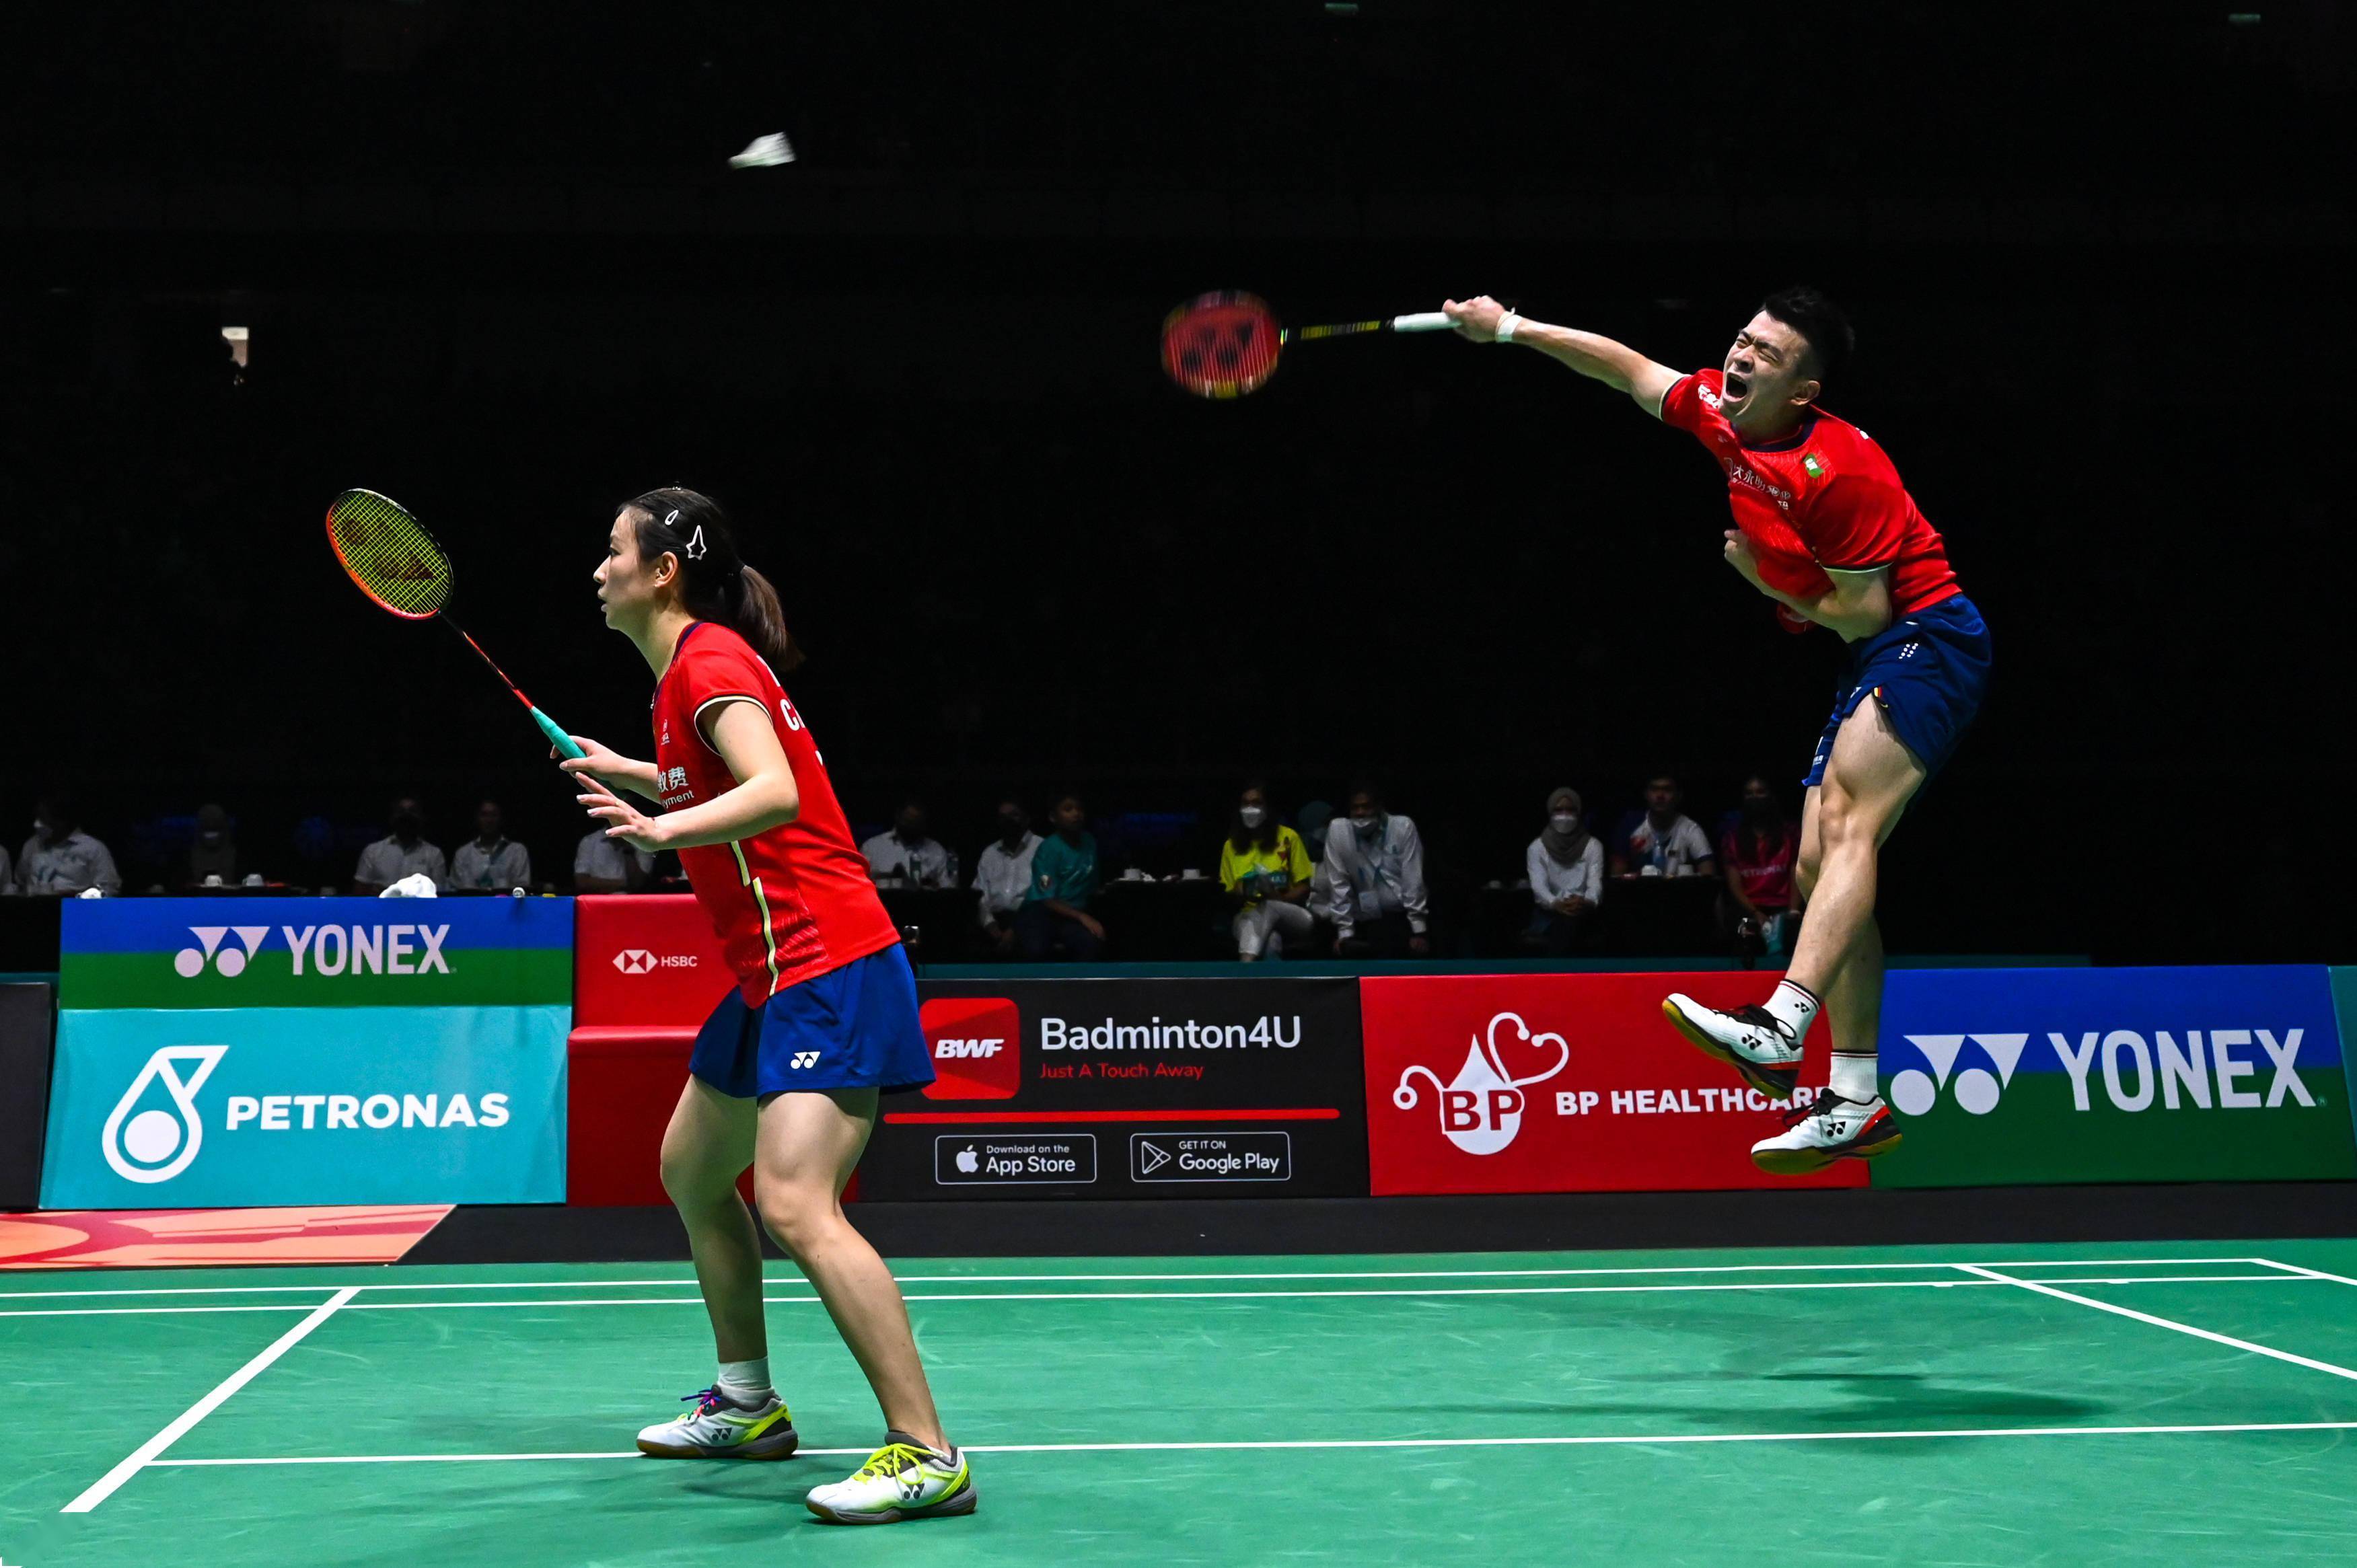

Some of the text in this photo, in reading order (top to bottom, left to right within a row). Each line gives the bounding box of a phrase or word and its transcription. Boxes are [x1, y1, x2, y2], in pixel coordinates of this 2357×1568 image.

[661, 789, 695, 809] yment
[282, 924, 449, 976] YONEX
[661, 956, 697, 967] HSBC
[1041, 1015, 1301, 1051] Badminton4U
[935, 1039, 1005, 1059] BWF
[1040, 1062, 1204, 1080] Just A Touch Away
[2047, 1029, 2316, 1112] YONEX
[226, 1092, 510, 1130] PETRONAS
[1443, 1090, 1522, 1131] BP
[1556, 1087, 1829, 1115] BP HEALTHCAR
[986, 1144, 1071, 1154] Download on the
[1178, 1140, 1227, 1150] GET IT ON
[986, 1155, 1076, 1177] App Store
[1179, 1152, 1280, 1174] Google Play
